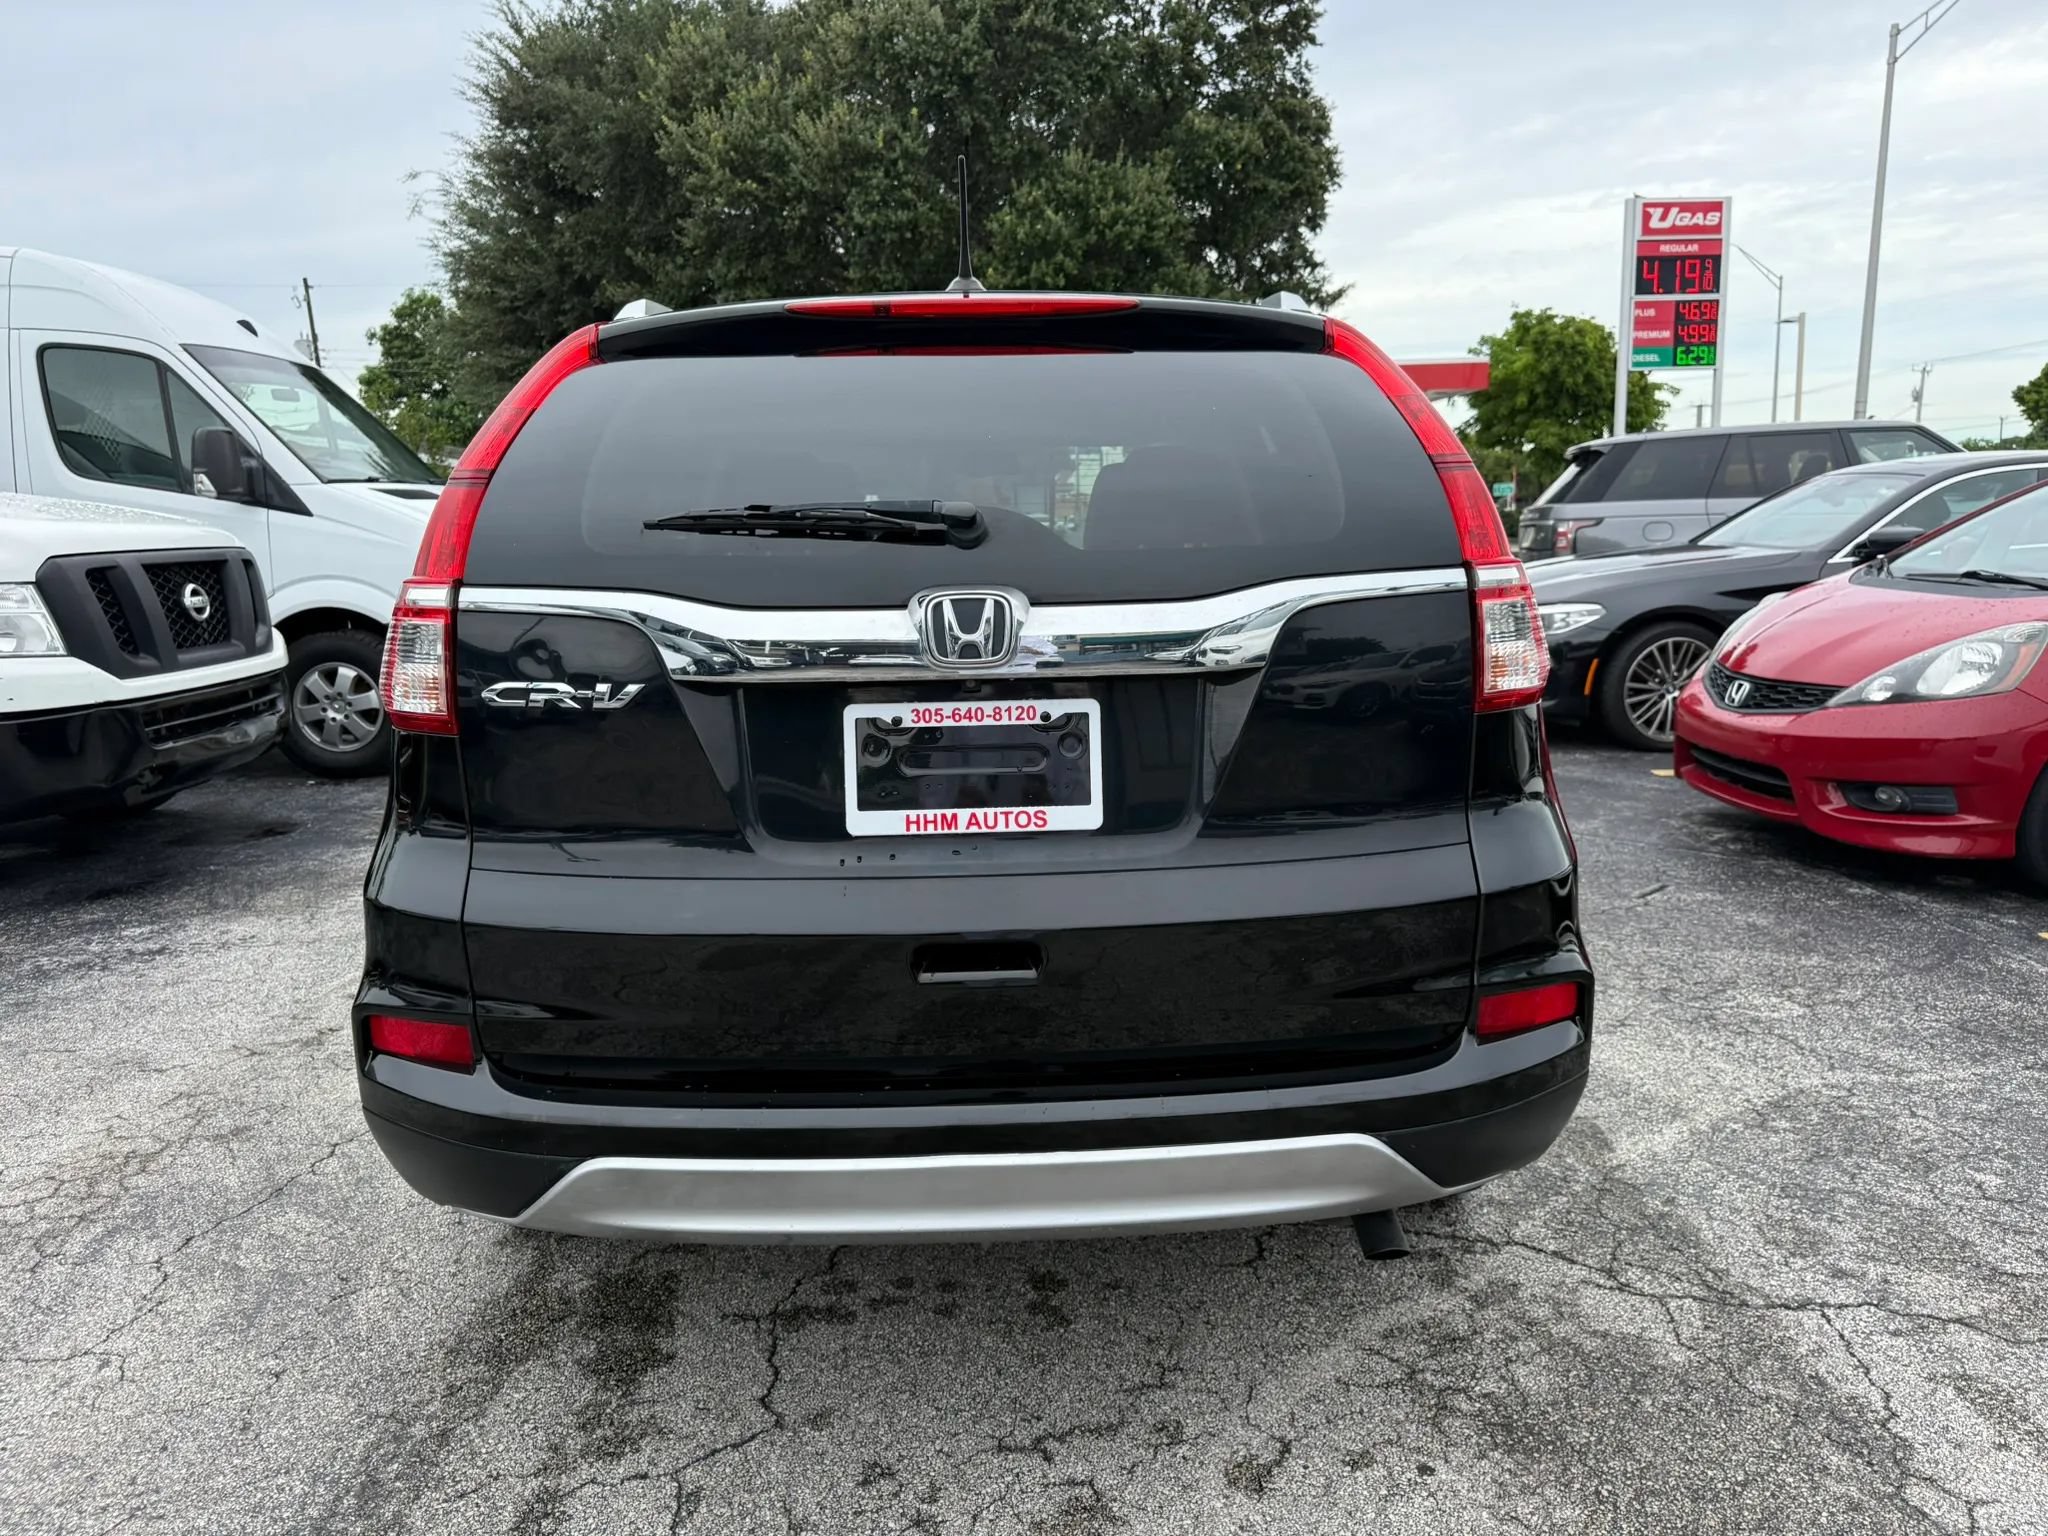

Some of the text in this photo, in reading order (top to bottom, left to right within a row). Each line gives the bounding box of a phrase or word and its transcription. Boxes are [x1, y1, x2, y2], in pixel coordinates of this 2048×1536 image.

[1659, 243, 1699, 253] REGULAR
[1643, 258, 1700, 294] 4.19
[1634, 307, 1656, 318] PLUS
[1632, 329, 1671, 339] PREMIUM
[1632, 353, 1661, 362] DIESEL
[480, 681, 647, 711] CR-V
[910, 705, 1037, 725] 305-640-8120
[905, 809, 1048, 832] HHM AUTOS
